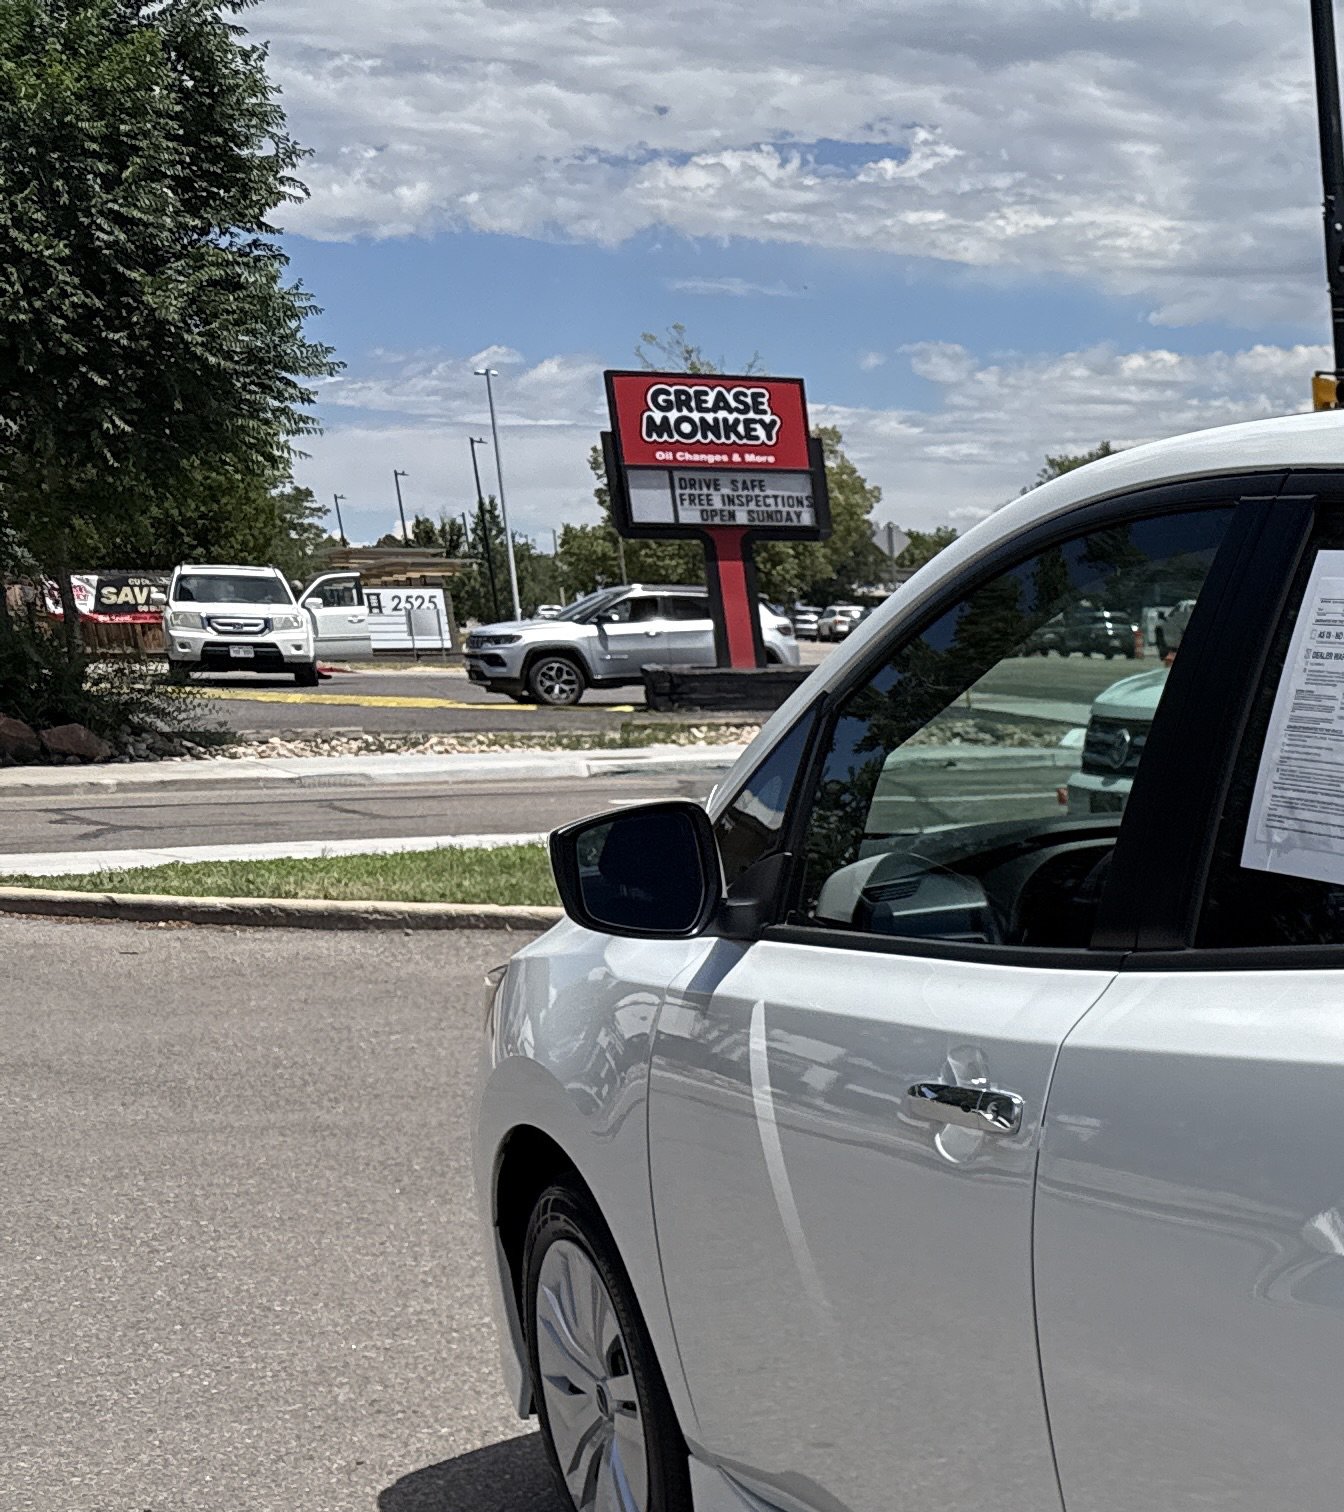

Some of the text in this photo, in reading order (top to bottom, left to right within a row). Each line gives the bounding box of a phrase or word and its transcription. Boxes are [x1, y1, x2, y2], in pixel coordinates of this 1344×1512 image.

[650, 387, 769, 416] GREASE
[644, 414, 778, 443] MONKEY
[655, 451, 776, 464] Oil Changes & More
[678, 477, 767, 492] DRIVE SAFE
[678, 493, 814, 510] FREE INSPECTIONS
[700, 509, 803, 524] OPEN SUNDAY
[391, 595, 438, 611] 2525
